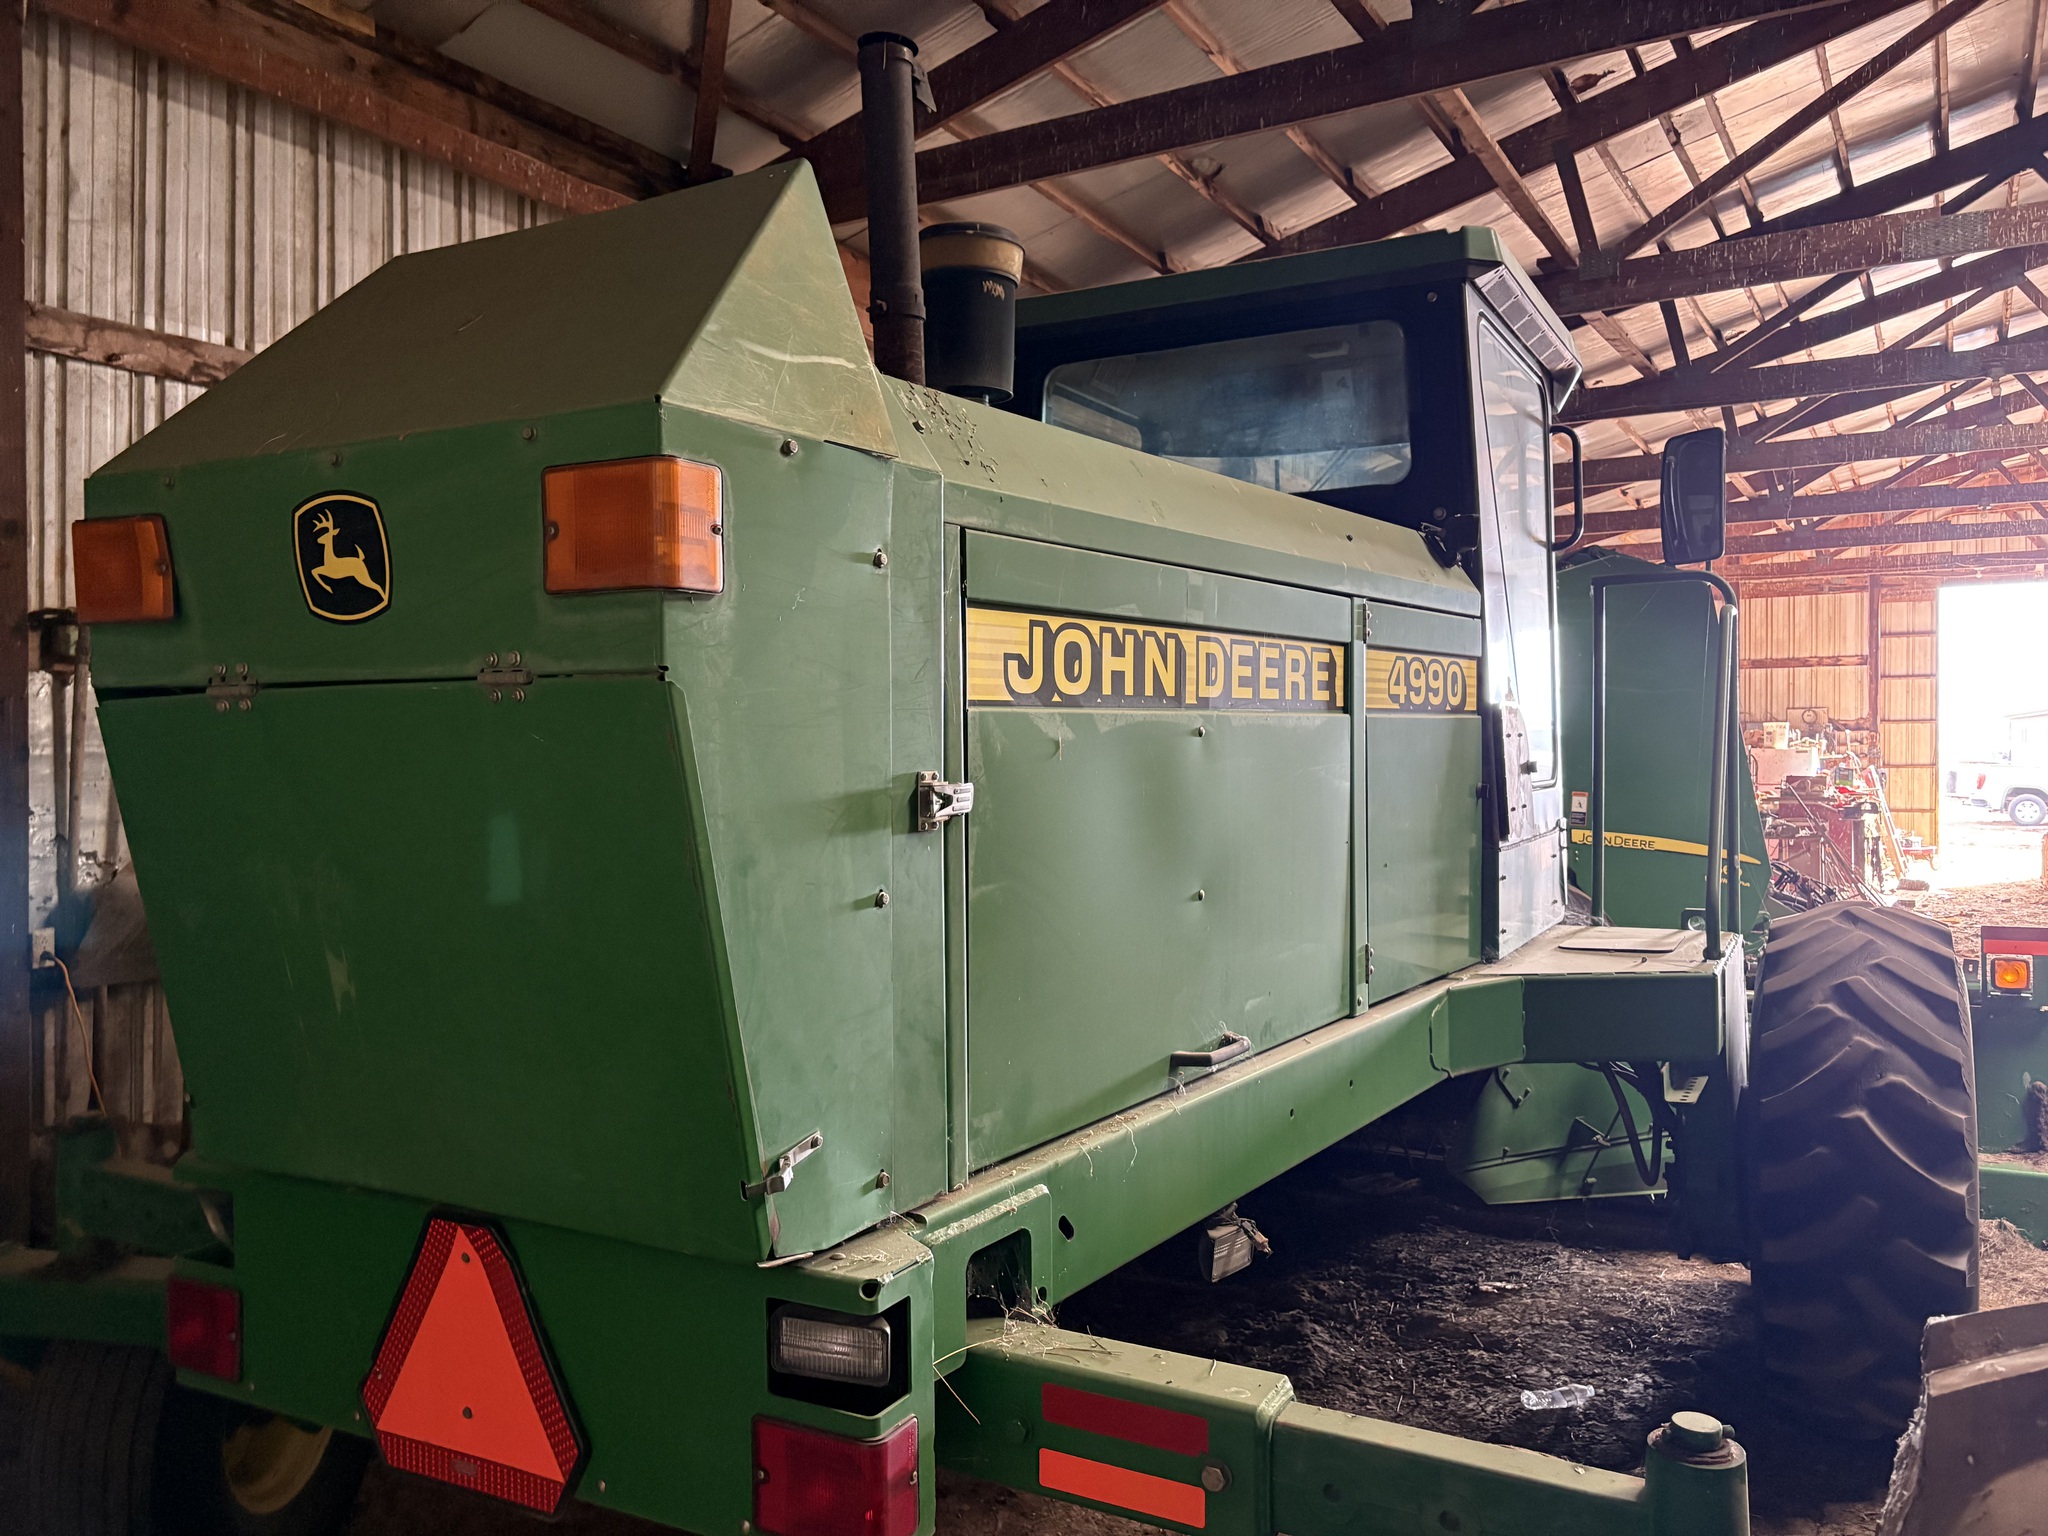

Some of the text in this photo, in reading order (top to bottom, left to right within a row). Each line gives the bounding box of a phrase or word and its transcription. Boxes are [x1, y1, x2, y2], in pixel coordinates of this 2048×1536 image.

[1004, 621, 1337, 704] JOHN DEERE
[1388, 657, 1466, 709] 4990
[1578, 832, 1612, 846] JON
